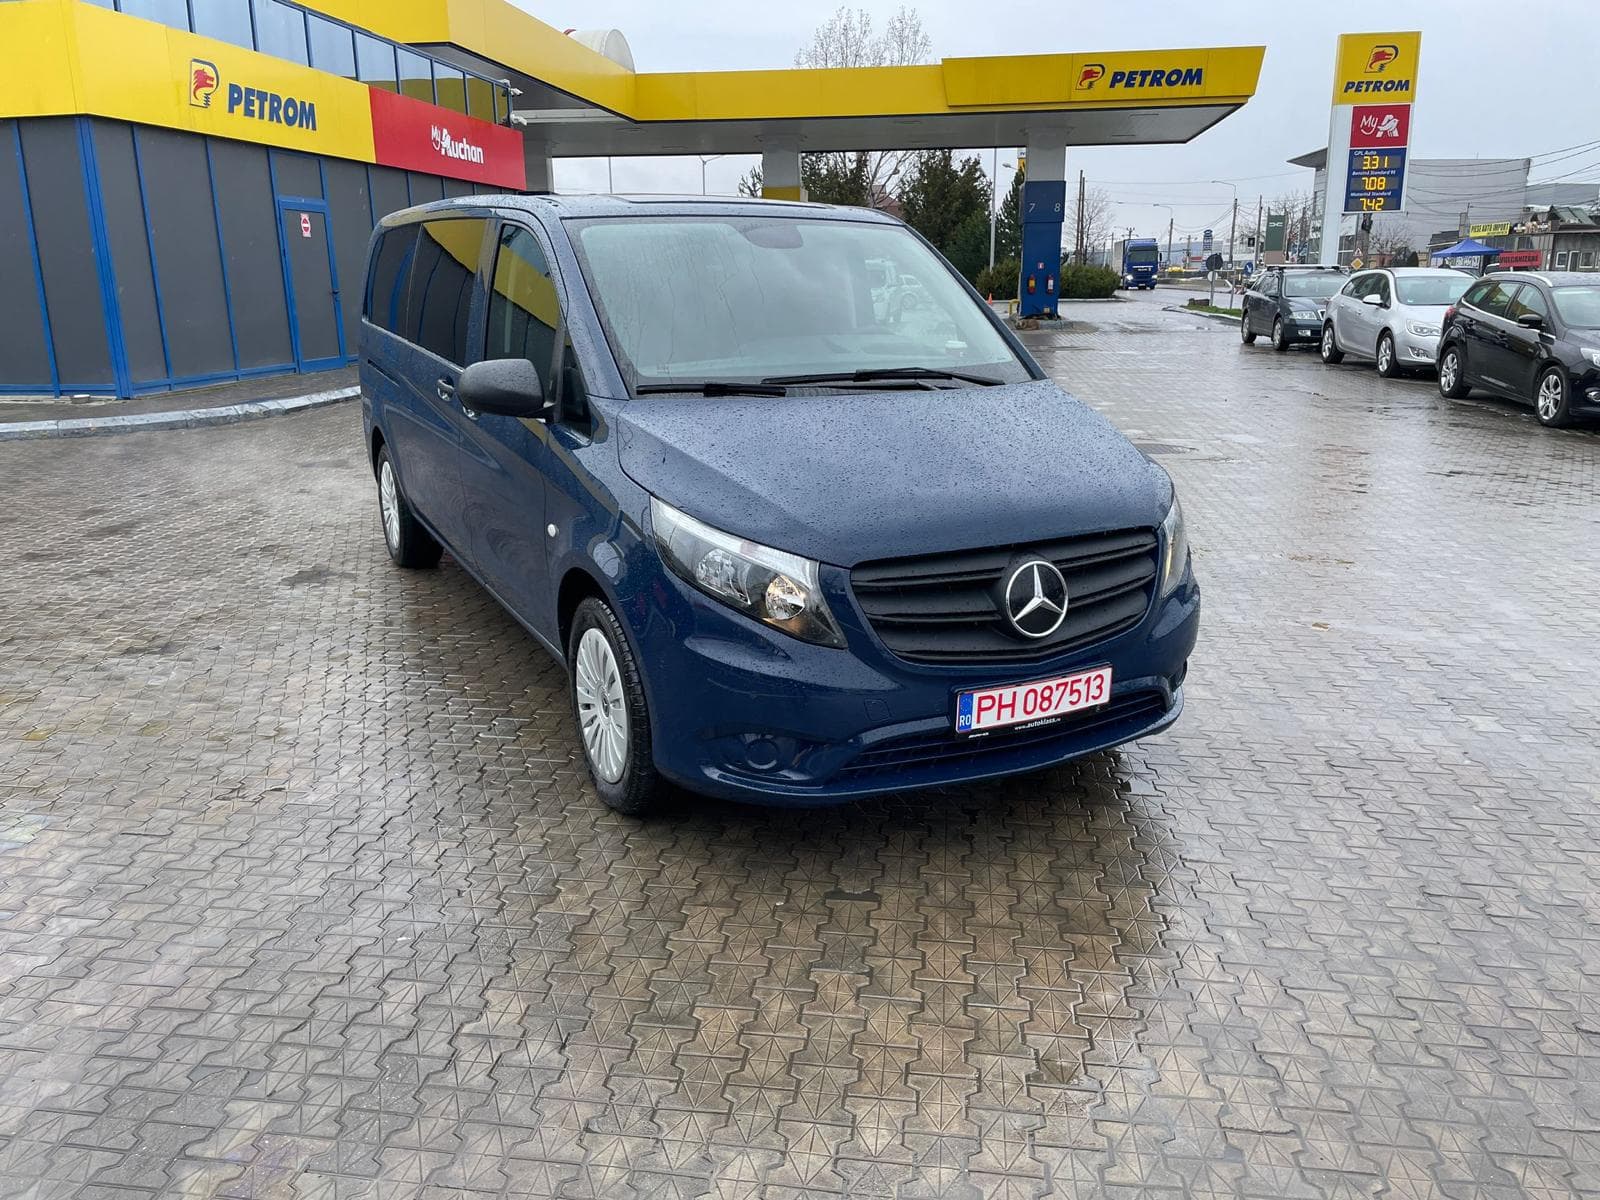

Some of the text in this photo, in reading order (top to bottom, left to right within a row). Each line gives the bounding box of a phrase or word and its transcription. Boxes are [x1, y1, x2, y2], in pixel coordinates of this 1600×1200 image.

[1108, 68, 1203, 89] PETROM
[1343, 79, 1410, 93] PETROM
[227, 83, 317, 132] PETROM
[1360, 114, 1379, 135] My
[431, 124, 484, 164] My Auchan
[1028, 202, 1061, 213] 7 8
[1482, 223, 1493, 232] AUTO
[1493, 222, 1509, 232] IMPORT
[975, 673, 1105, 724] PH 087513
[959, 714, 972, 726] RO
